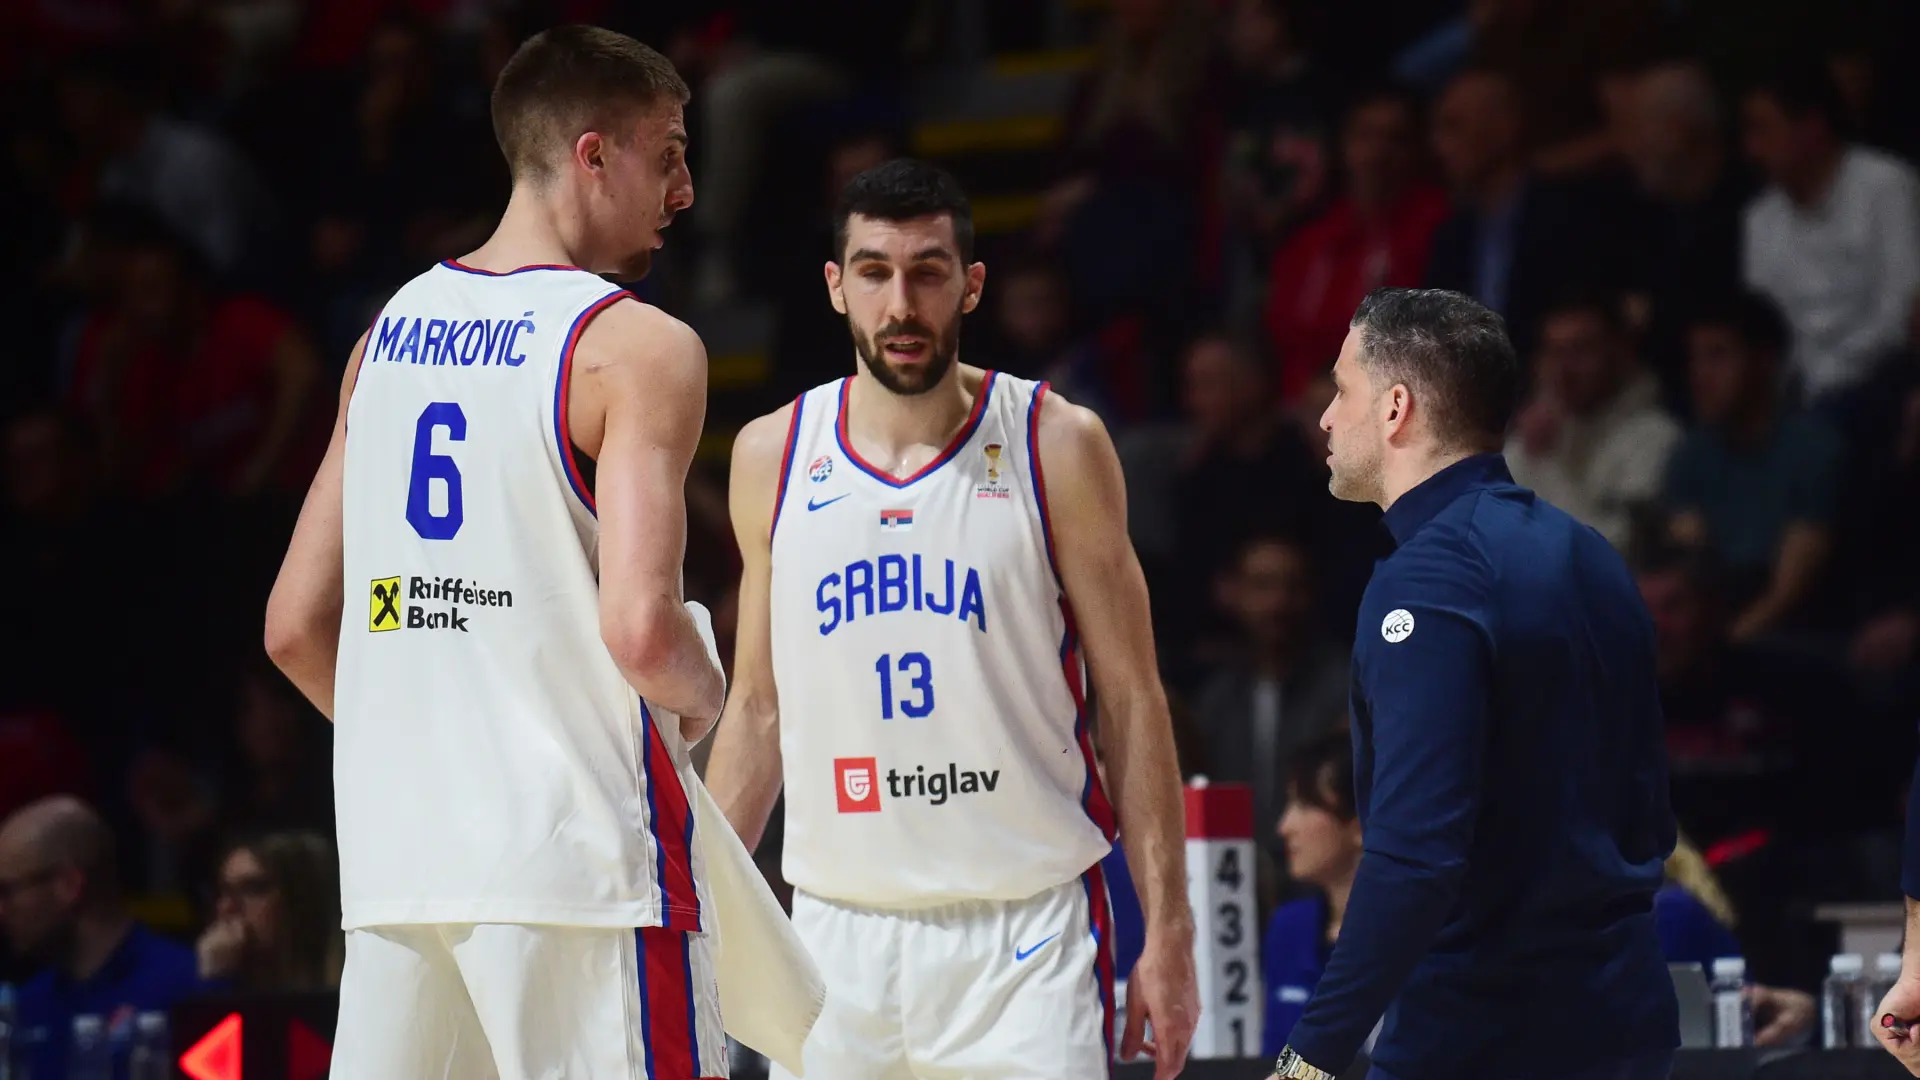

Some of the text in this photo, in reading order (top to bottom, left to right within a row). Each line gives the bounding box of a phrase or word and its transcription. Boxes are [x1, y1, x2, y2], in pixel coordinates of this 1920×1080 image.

[373, 311, 535, 367] MARKOVIĆ
[405, 402, 467, 540] 6
[816, 554, 987, 636] SRBIJA
[875, 652, 935, 720] 13
[886, 763, 1001, 805] triglav
[1215, 847, 1242, 890] 4
[1216, 902, 1243, 946] 3
[1222, 960, 1248, 1004] 2
[1230, 1017, 1247, 1056] 1
